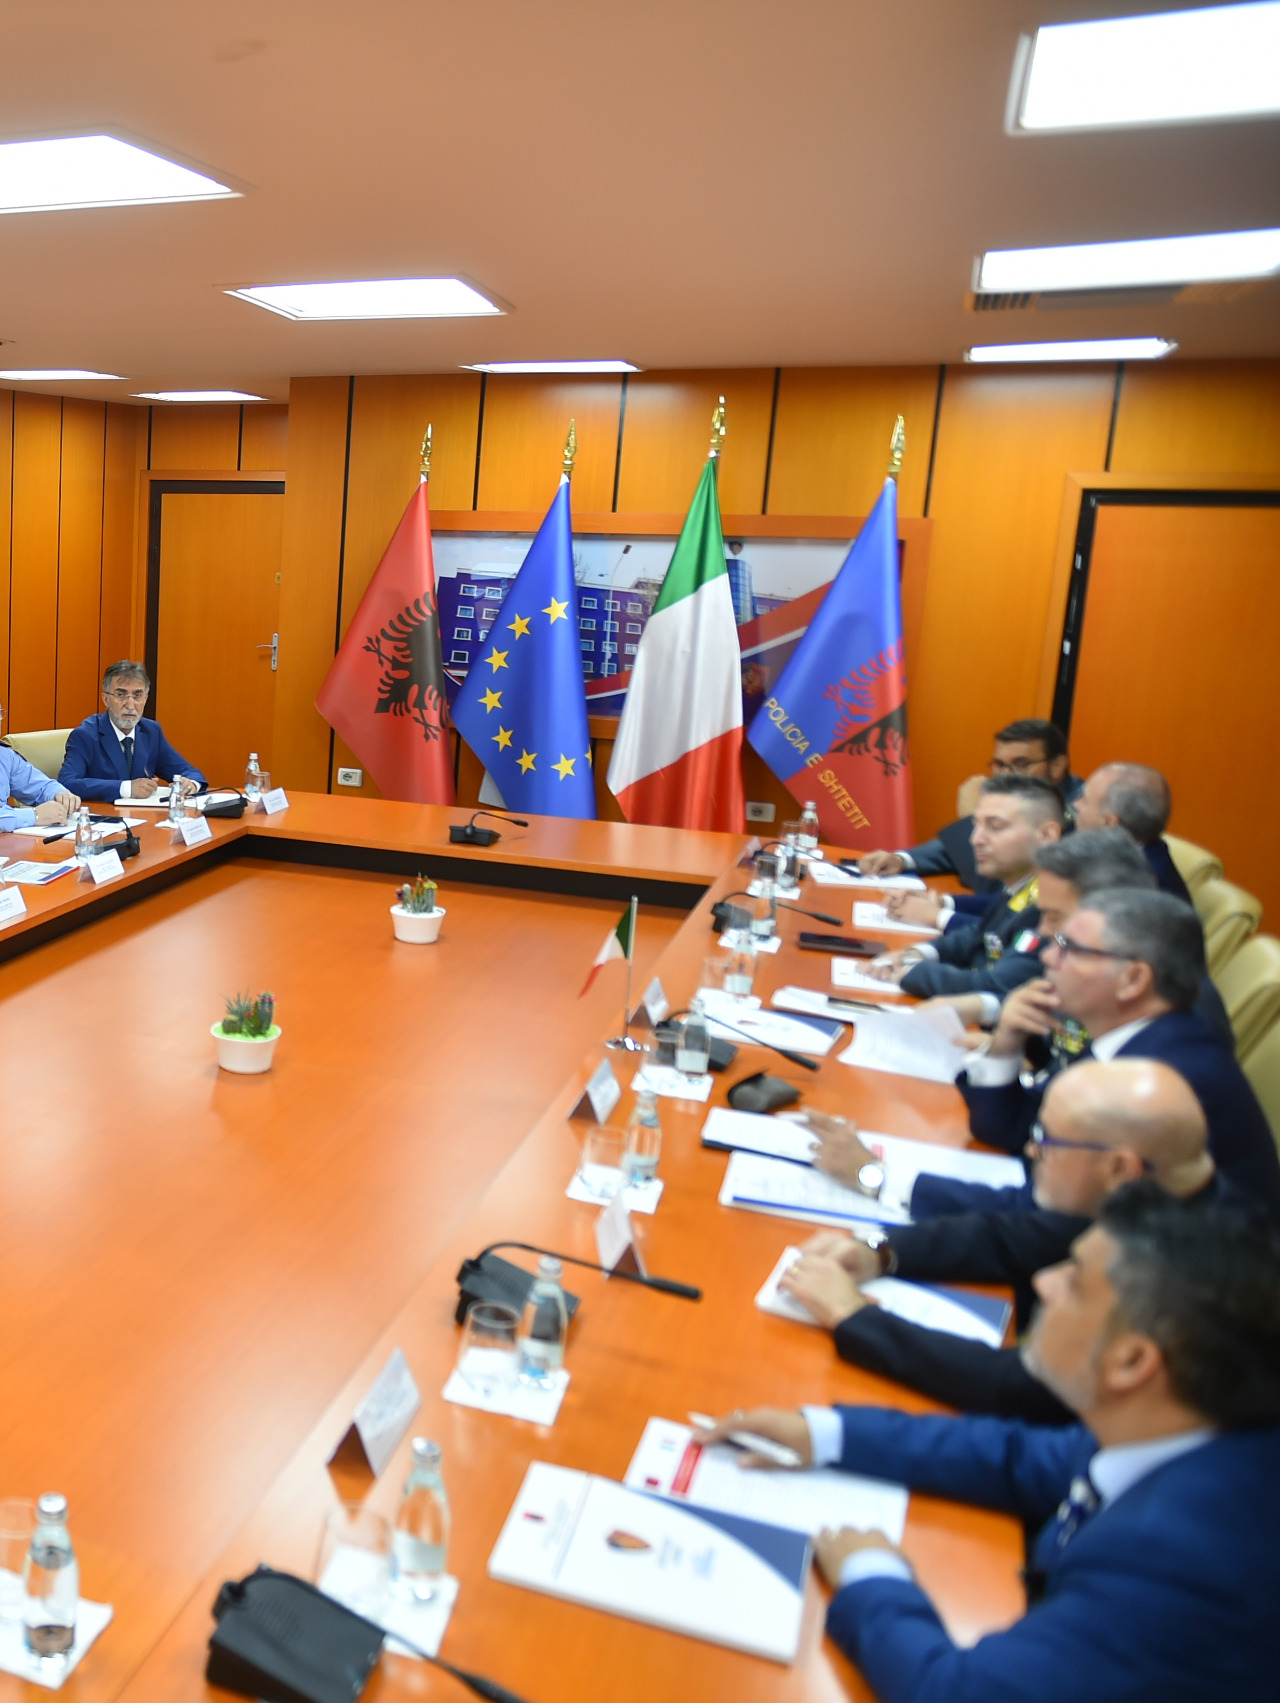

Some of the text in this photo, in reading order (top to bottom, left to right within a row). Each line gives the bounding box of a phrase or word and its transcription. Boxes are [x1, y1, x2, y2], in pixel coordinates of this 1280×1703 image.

[765, 697, 872, 830] POLICIA E SHTETIT
